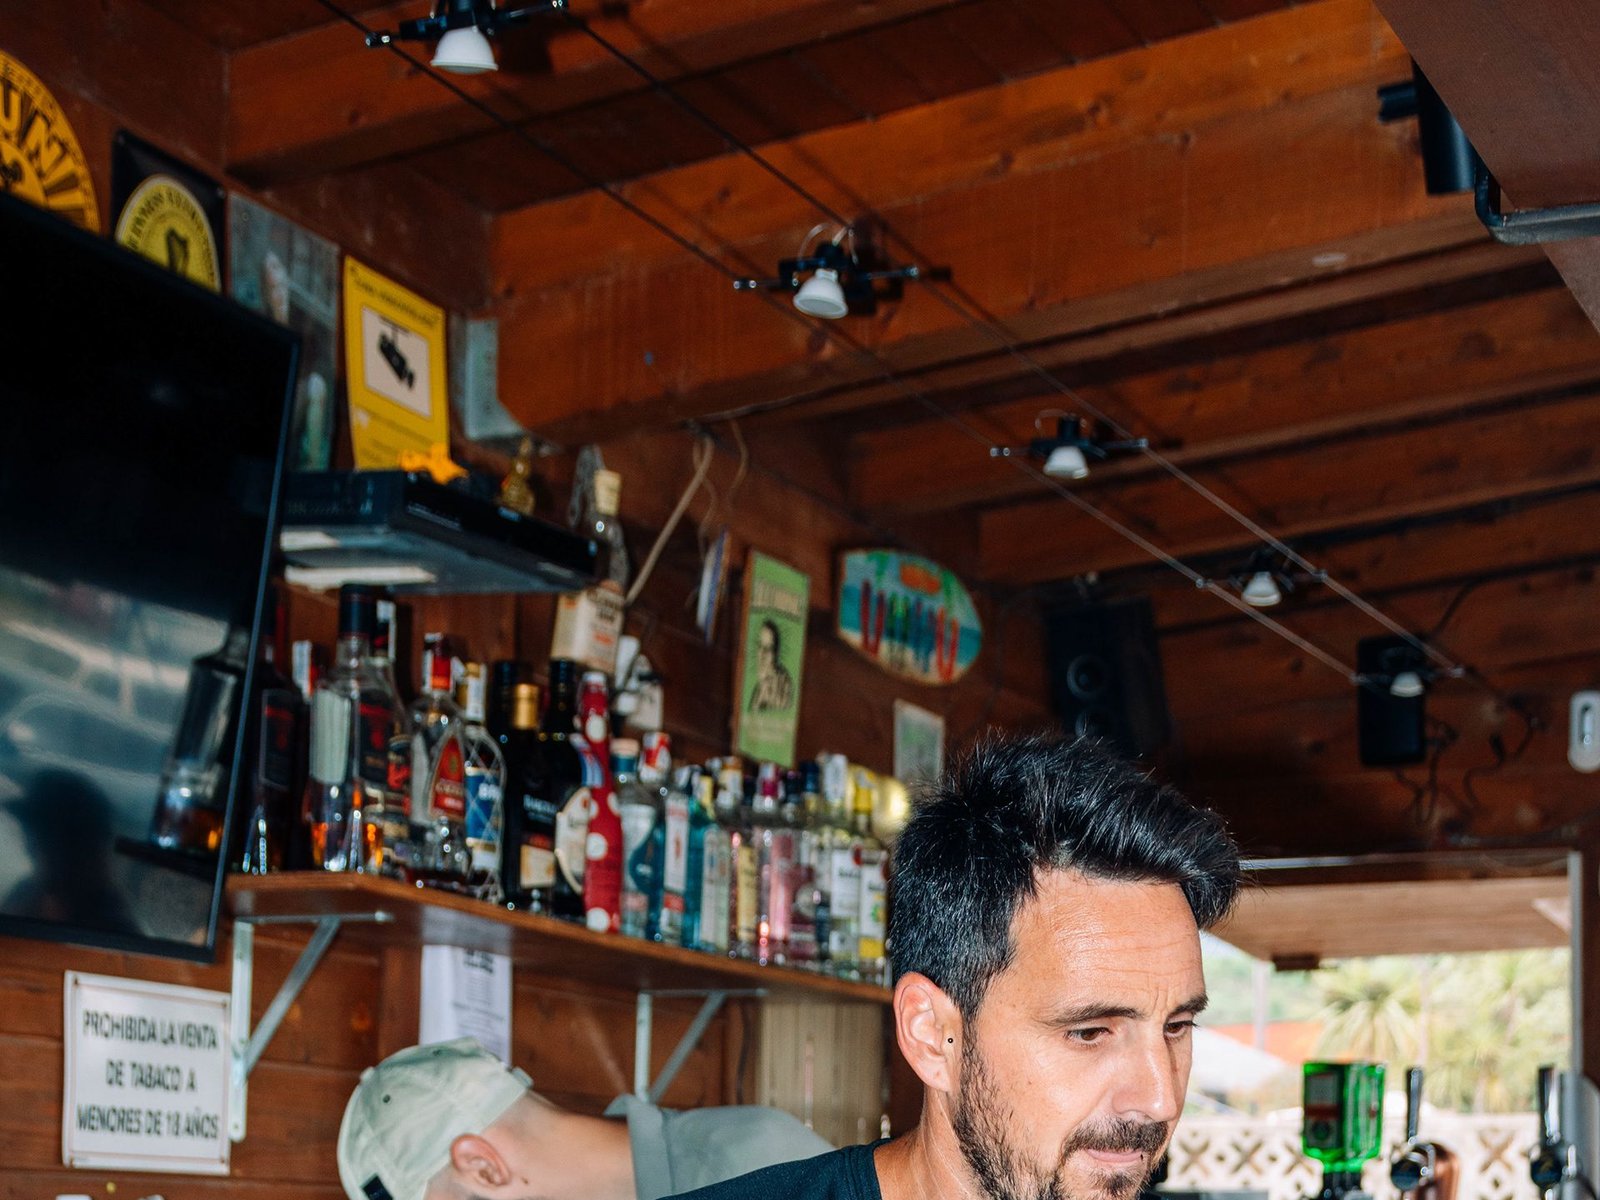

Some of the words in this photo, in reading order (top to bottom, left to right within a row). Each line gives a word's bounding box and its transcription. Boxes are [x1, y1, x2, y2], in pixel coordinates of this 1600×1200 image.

[83, 1009, 157, 1044] PROHIBIDA
[160, 1019, 176, 1045] LA
[177, 1022, 218, 1050] VENTA
[106, 1059, 124, 1087] DE
[130, 1061, 182, 1092] TABACO
[186, 1067, 197, 1092] A
[77, 1104, 142, 1134] MENORES
[145, 1110, 161, 1135] DE
[166, 1112, 180, 1137] 18
[184, 1108, 219, 1140] AÑOS
